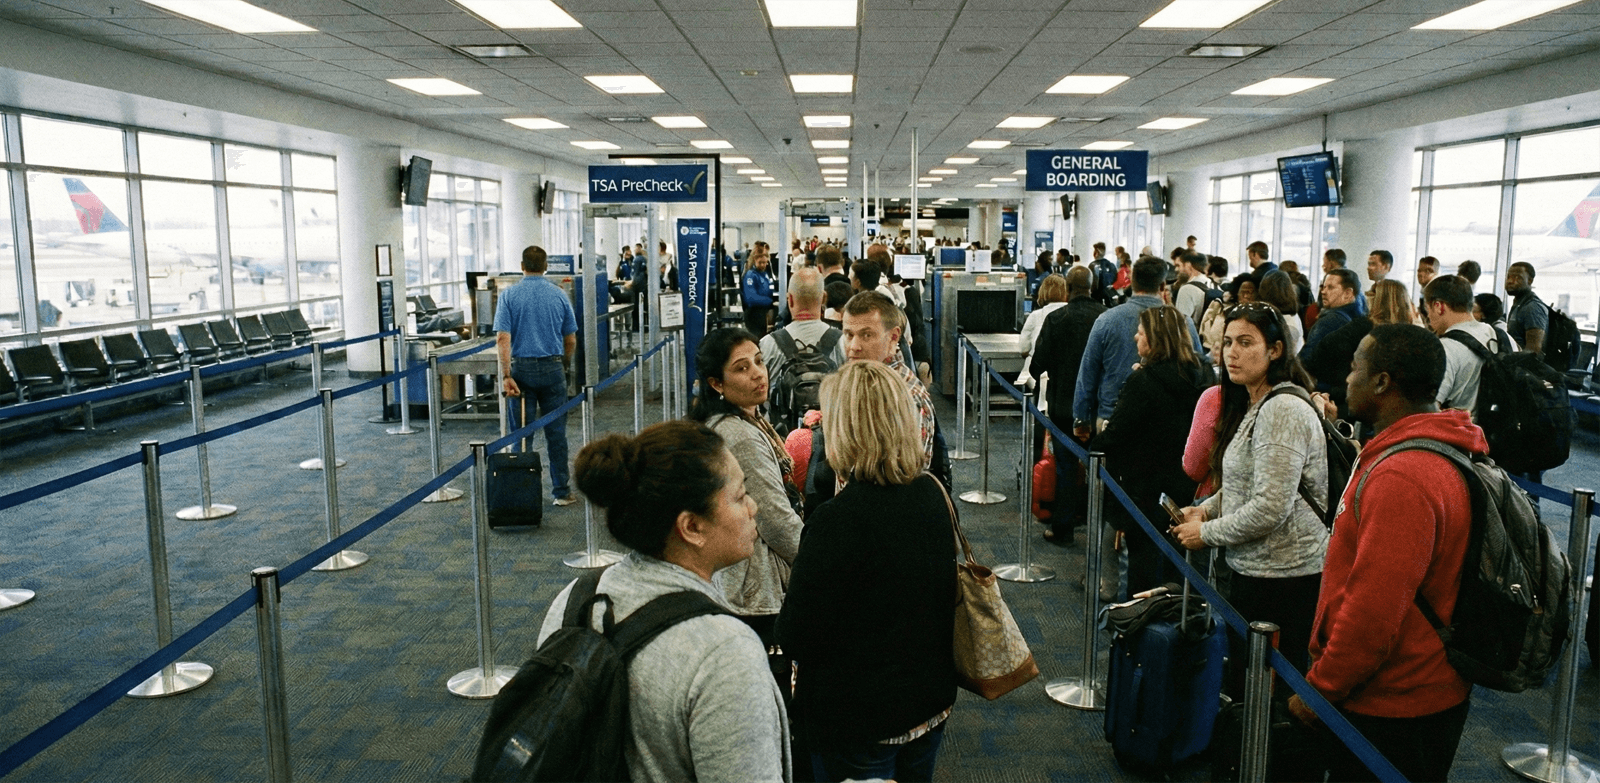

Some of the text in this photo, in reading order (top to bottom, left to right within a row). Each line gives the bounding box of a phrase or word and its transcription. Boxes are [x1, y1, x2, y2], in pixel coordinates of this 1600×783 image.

[1051, 155, 1122, 170] GENERAL
[591, 178, 684, 191] TSA PreCheck
[1046, 172, 1127, 187] BOARDING
[688, 243, 698, 260] TSA
